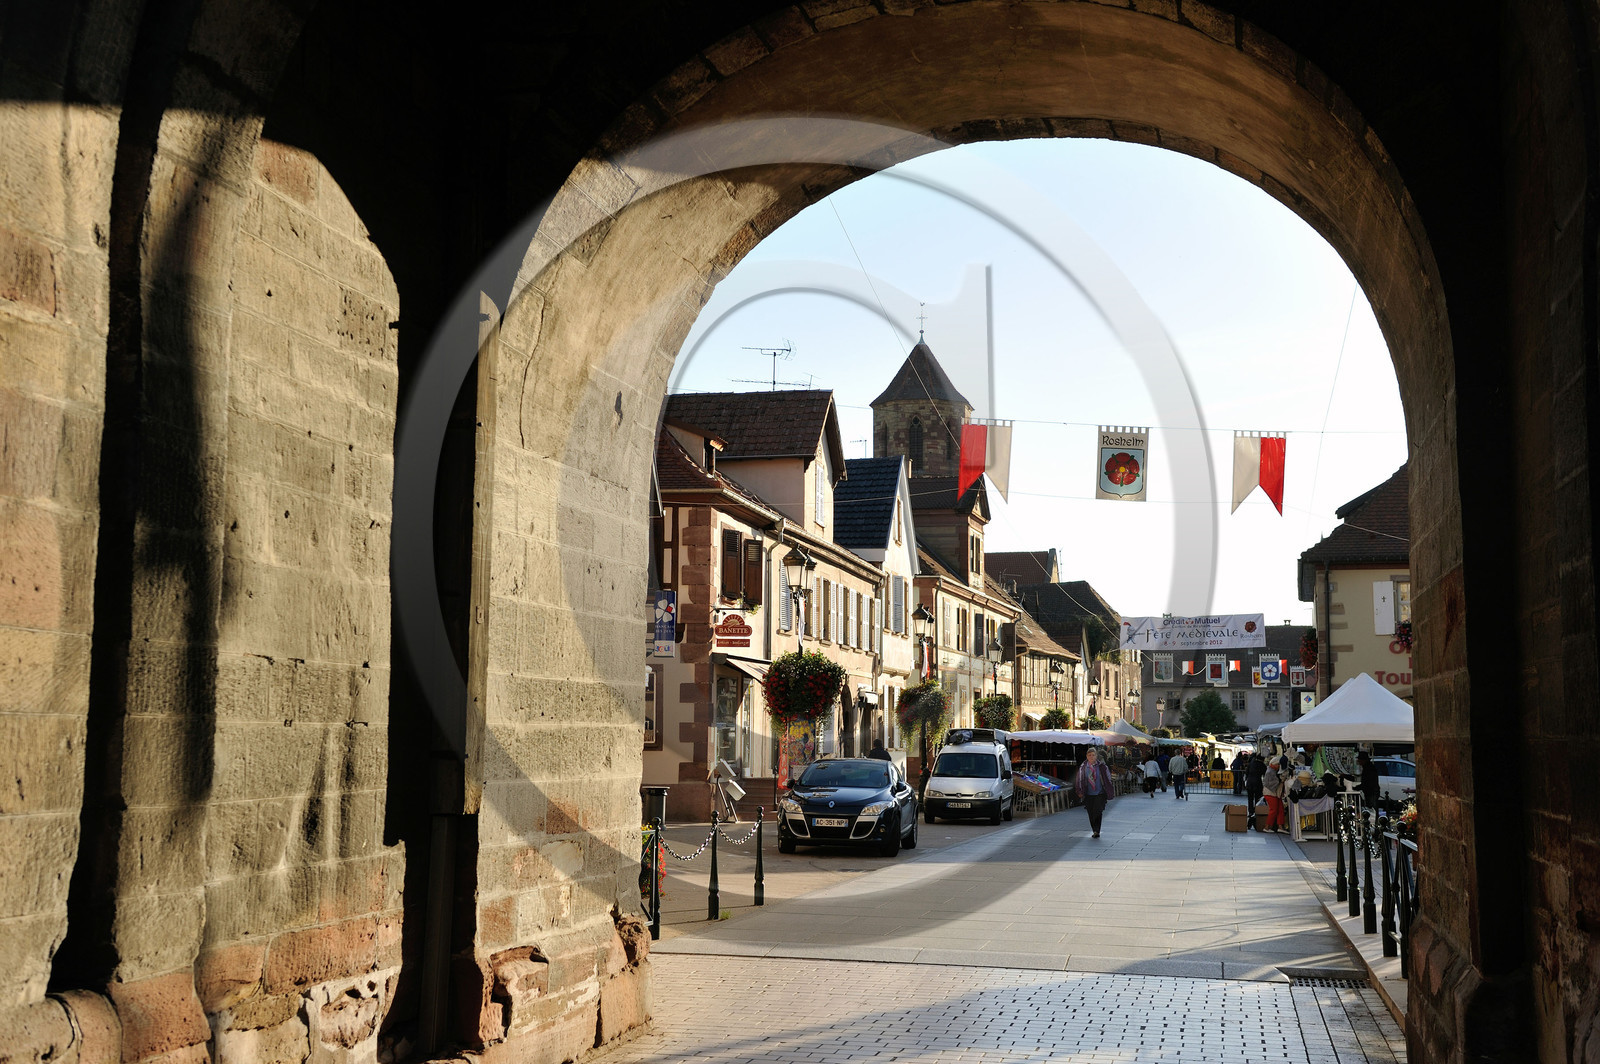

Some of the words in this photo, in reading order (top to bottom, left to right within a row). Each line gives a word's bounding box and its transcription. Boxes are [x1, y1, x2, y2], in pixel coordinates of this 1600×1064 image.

[1102, 435, 1144, 446] Rosheim
[1163, 617, 1185, 626] Crédit
[1194, 617, 1220, 625] Mutuel
